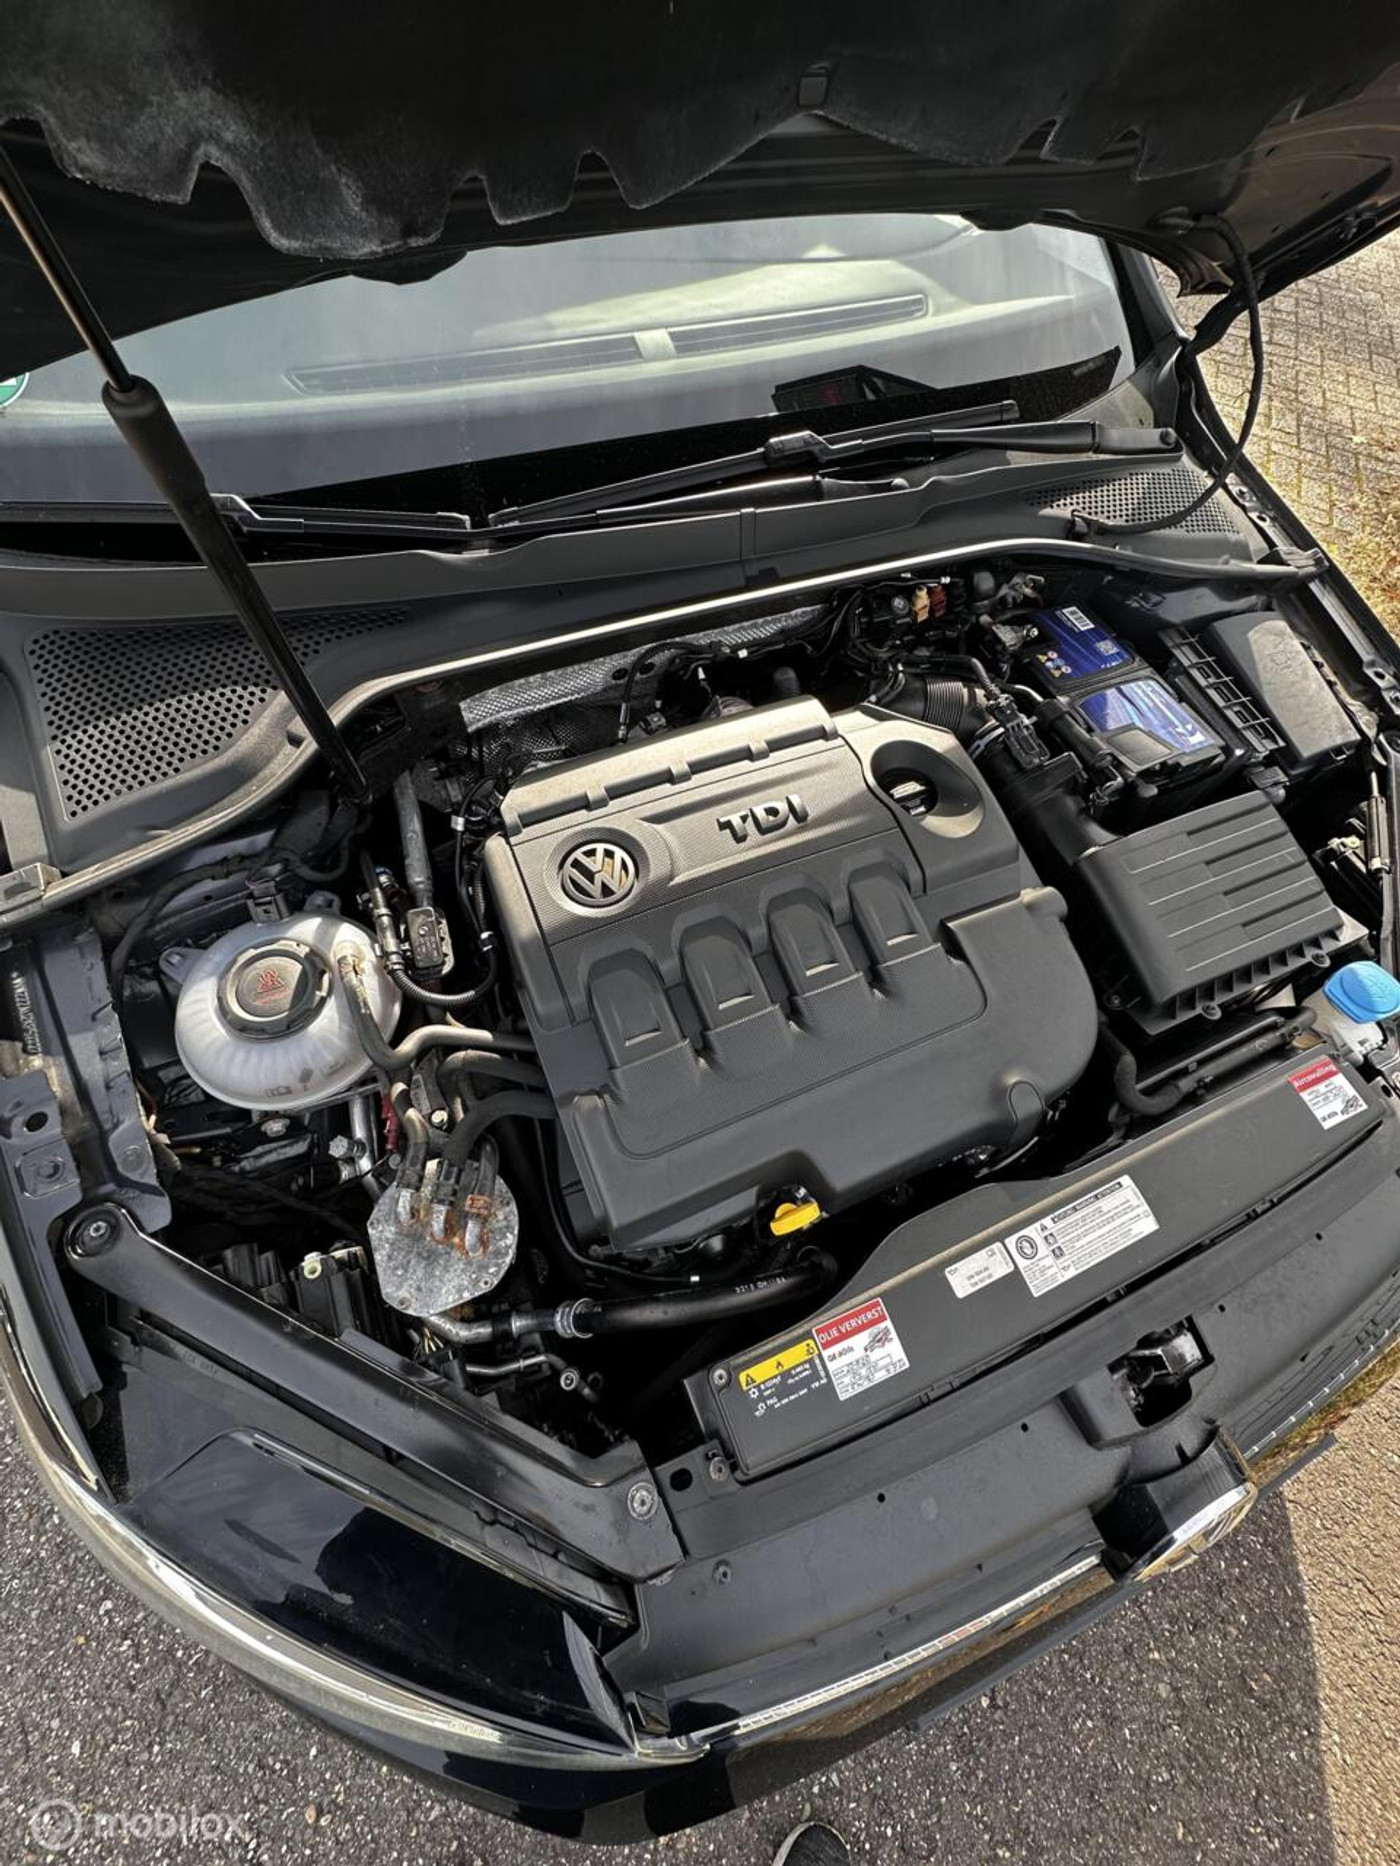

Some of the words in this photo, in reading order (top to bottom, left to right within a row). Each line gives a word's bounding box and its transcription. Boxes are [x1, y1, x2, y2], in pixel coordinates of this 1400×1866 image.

[717, 795, 809, 844] TDI
[819, 1327, 839, 1343] OLIE
[839, 1306, 883, 1333] VERVERST
